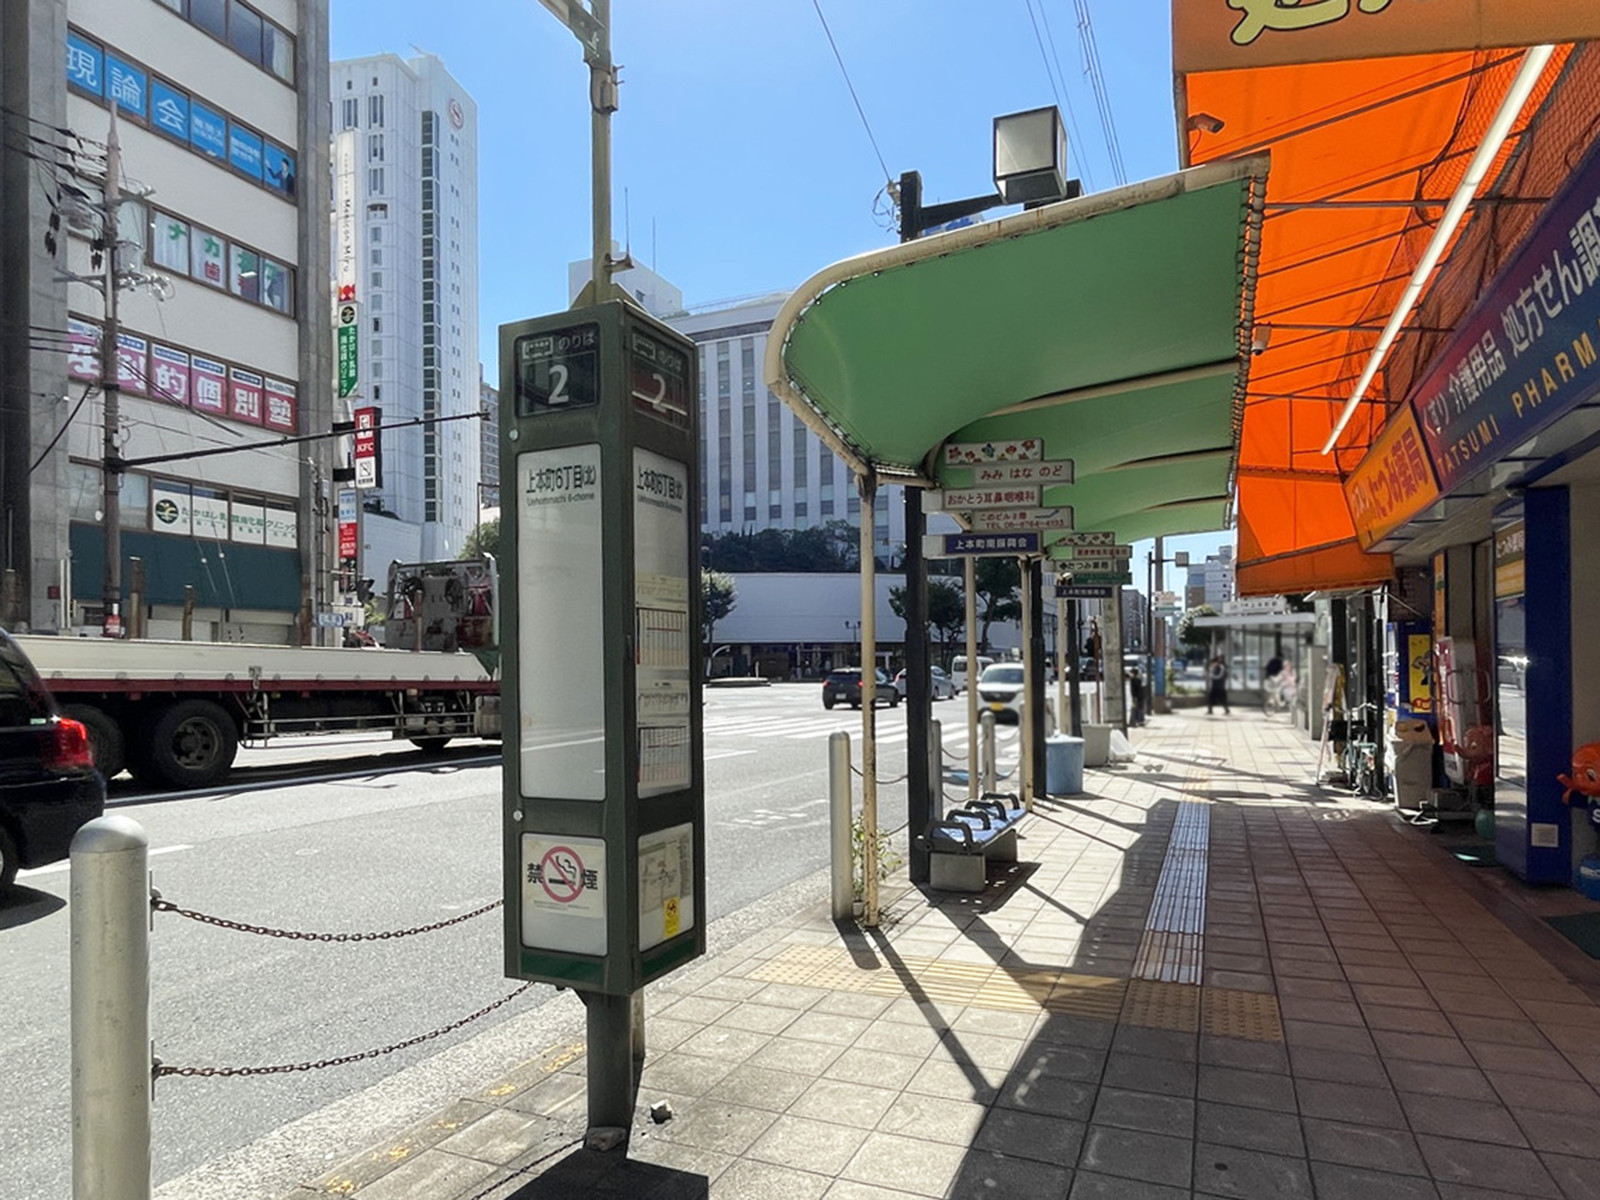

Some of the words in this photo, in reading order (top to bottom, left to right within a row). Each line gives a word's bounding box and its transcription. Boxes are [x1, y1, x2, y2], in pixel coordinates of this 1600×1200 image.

[1449, 330, 1507, 414] 介護用品
[1500, 198, 1600, 359] 処方せん調
[558, 332, 595, 351] のりば
[548, 365, 570, 405] 2
[1511, 316, 1600, 418] PHARM
[1436, 413, 1501, 479] TATSUMI
[980, 469, 1004, 480] みみ
[1009, 467, 1033, 479] はな
[1039, 465, 1063, 477] のど
[527, 862, 544, 885] 禁
[582, 868, 598, 891] 煙
